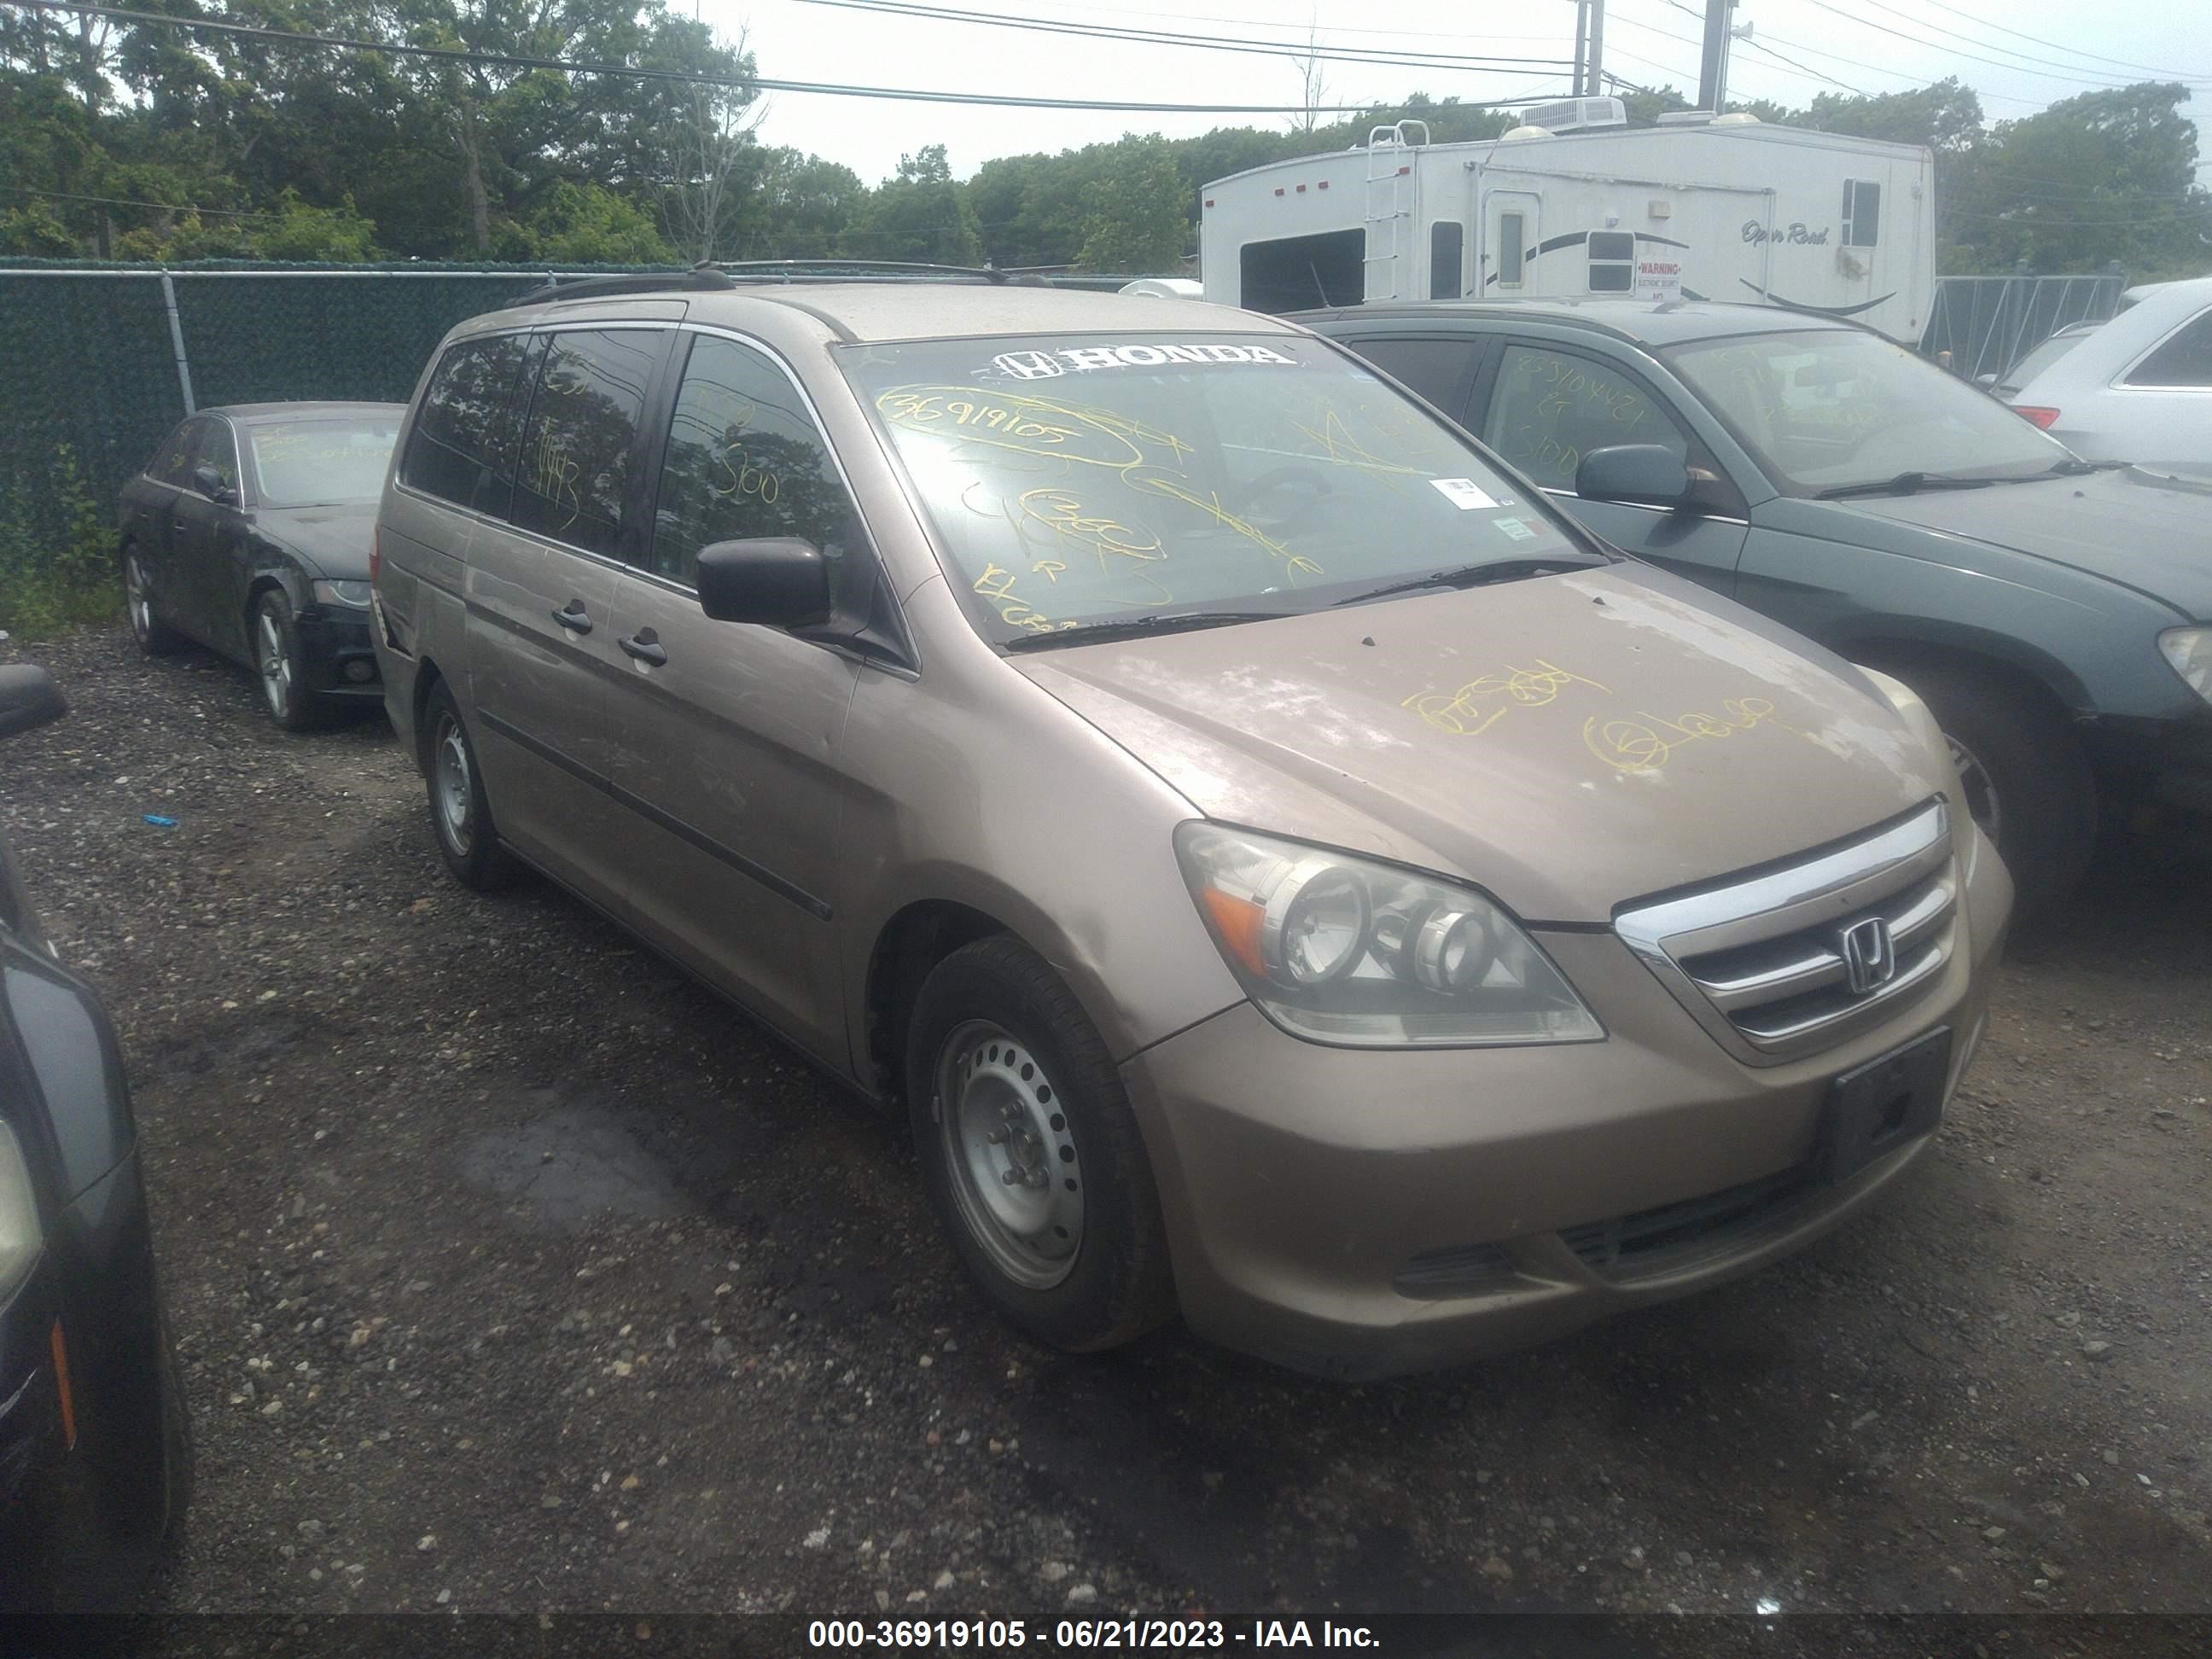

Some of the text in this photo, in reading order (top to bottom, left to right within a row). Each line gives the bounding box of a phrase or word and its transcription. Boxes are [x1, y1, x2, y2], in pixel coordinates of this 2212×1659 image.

[1742, 219, 1829, 247] Opn Road
[1640, 262, 1679, 275] WARNING
[1062, 345, 1297, 370] HONDA
